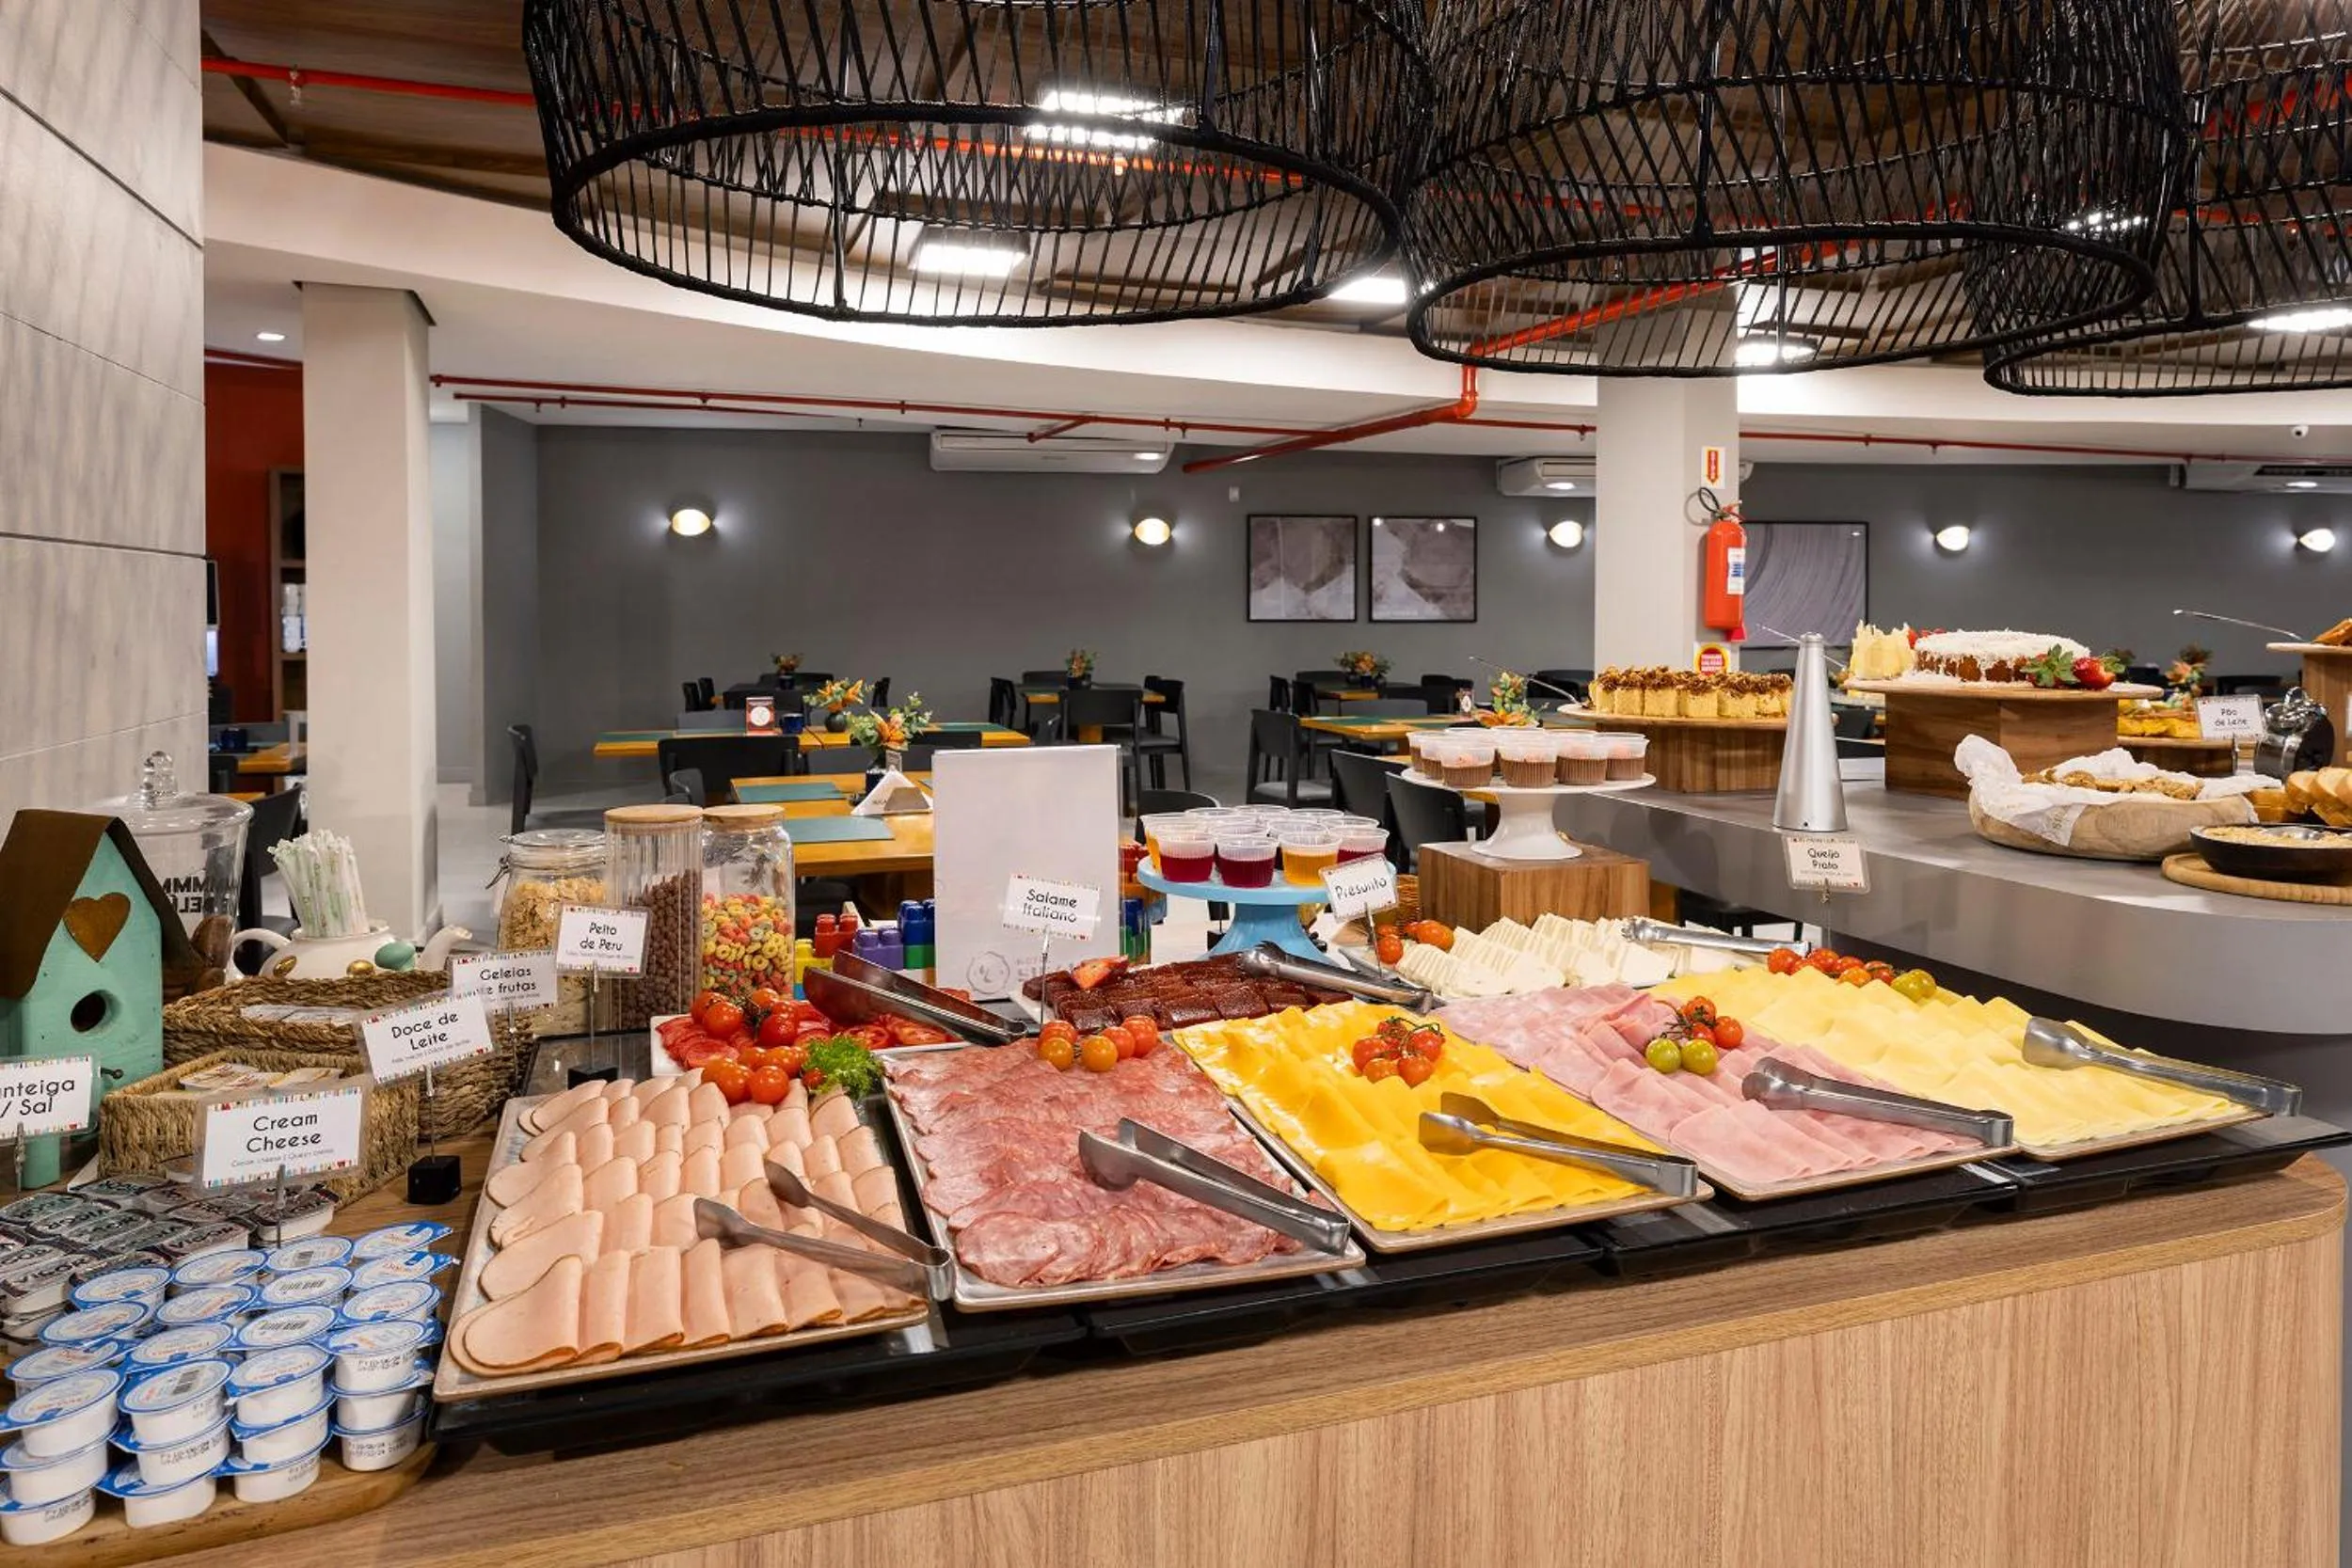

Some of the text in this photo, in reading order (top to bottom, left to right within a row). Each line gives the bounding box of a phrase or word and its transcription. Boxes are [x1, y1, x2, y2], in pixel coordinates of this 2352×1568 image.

[1807, 847, 1840, 859] Queijo
[1335, 877, 1387, 900] Presunto
[1025, 889, 1077, 909] Salame
[1023, 903, 1077, 923] Italiano
[589, 922, 617, 936] Peito
[580, 936, 624, 951] de Peru
[479, 966, 532, 981] Geleias
[498, 981, 537, 994] frutas
[390, 1012, 459, 1039] Doce de
[409, 1032, 449, 1052] Leite
[0, 1079, 75, 1099] nteiga
[19, 1096, 53, 1117] Sal
[253, 1114, 318, 1132] Cream
[246, 1132, 322, 1153] Cheese
